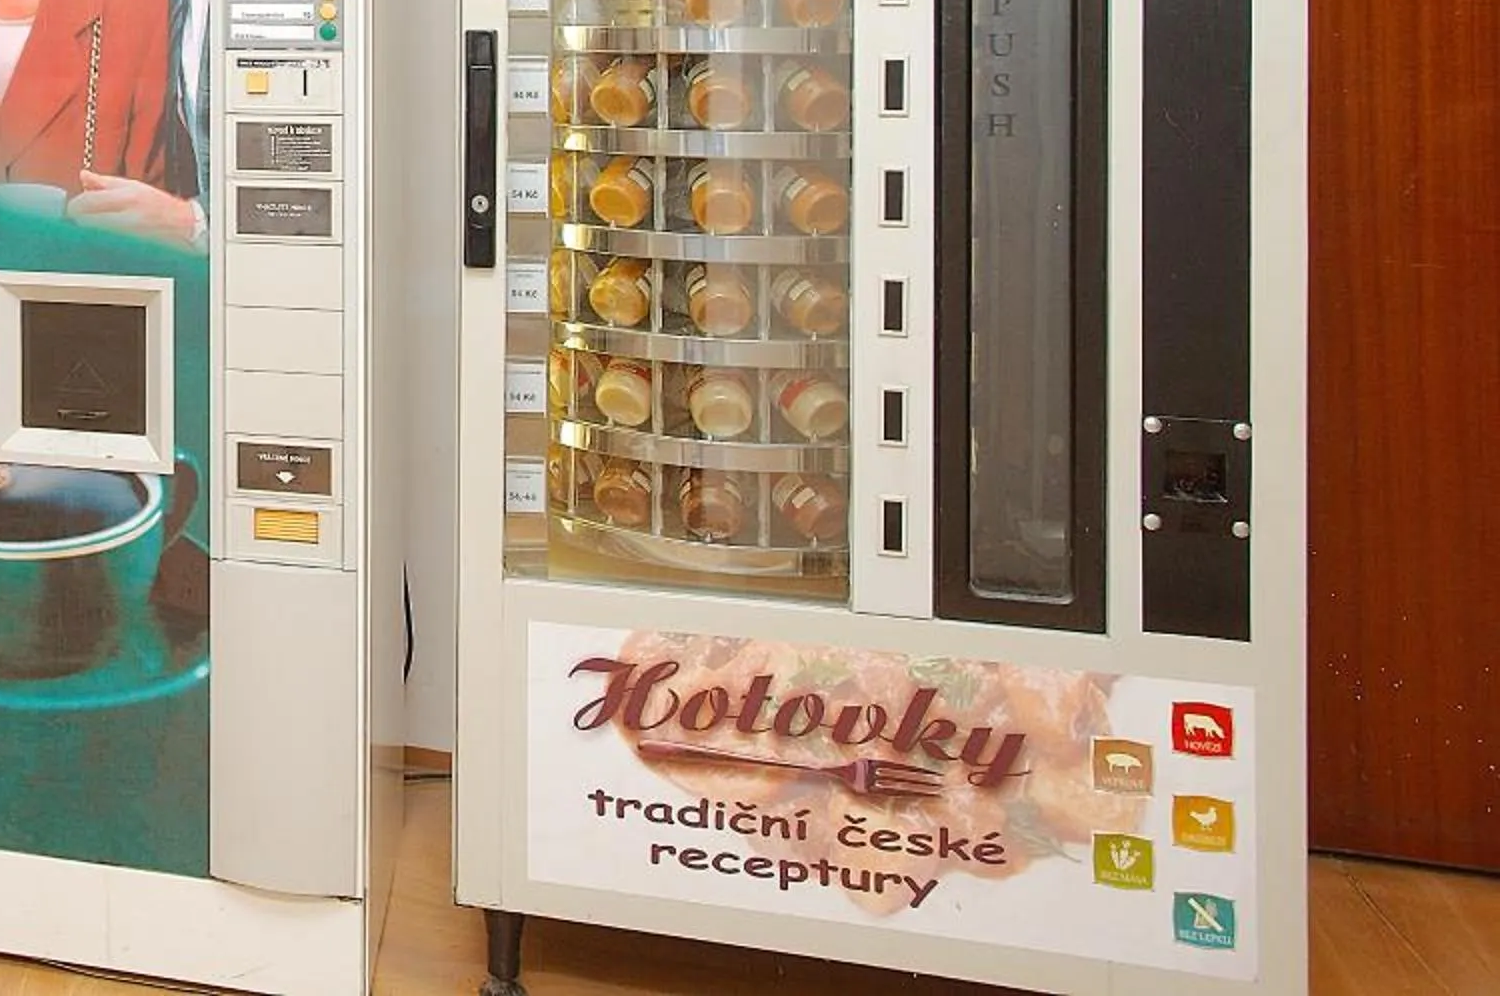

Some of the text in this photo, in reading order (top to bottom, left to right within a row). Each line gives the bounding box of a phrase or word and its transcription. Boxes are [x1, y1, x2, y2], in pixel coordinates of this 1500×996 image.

[568, 657, 1032, 787] Hotovky
[587, 788, 1008, 866] tradiční české
[650, 841, 940, 909] receptury
